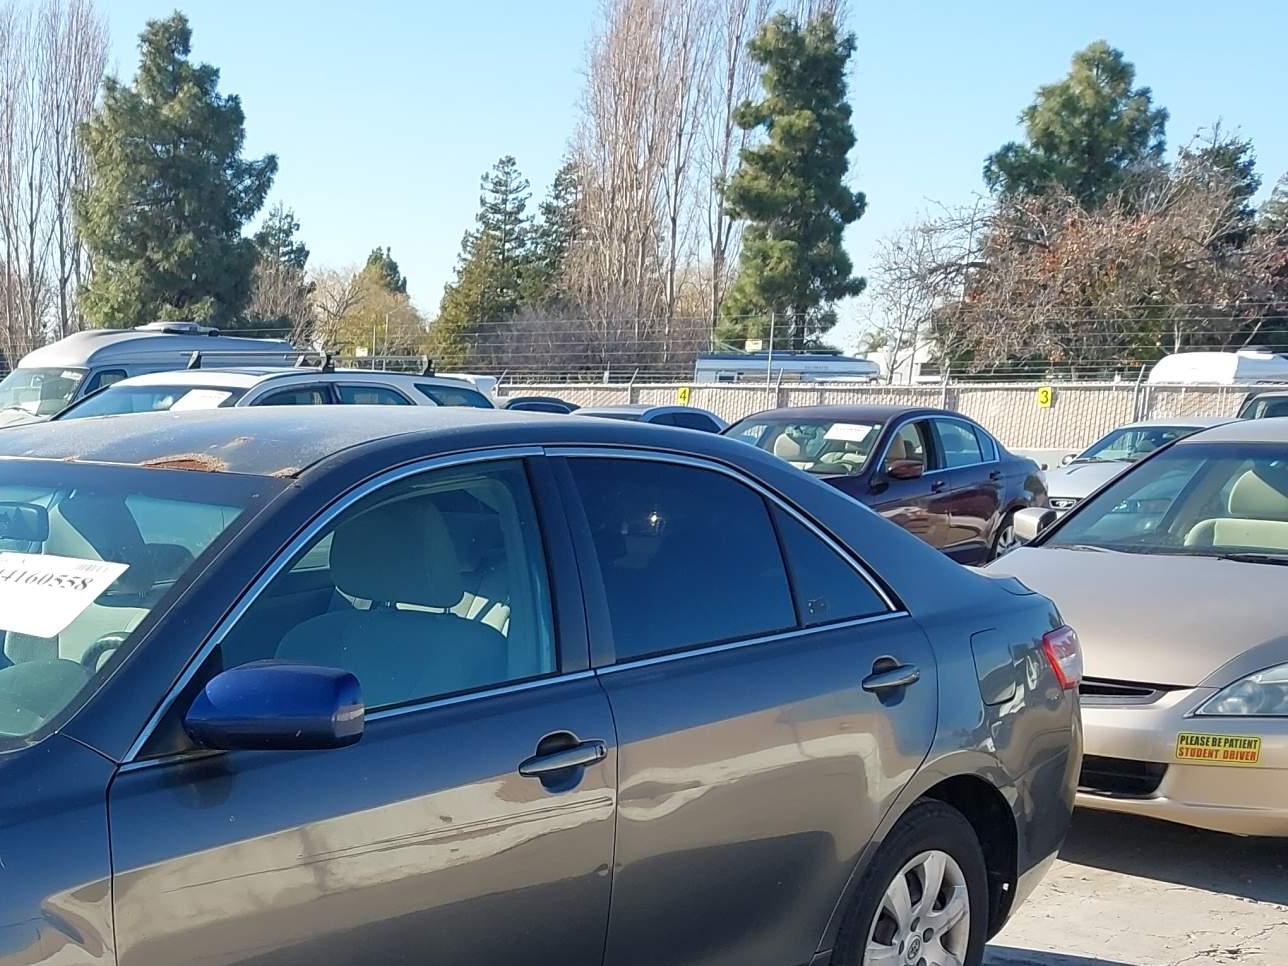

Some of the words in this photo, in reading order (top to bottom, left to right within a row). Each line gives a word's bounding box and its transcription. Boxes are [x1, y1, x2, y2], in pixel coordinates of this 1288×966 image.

[679, 388, 687, 401] 4
[1040, 390, 1049, 404] 3
[1180, 735, 1210, 746] PLEASE
[1211, 737, 1223, 747] BE
[1224, 738, 1258, 748] PATIENT
[1179, 747, 1220, 758] STUDENT
[1223, 750, 1256, 760] DRIVER
